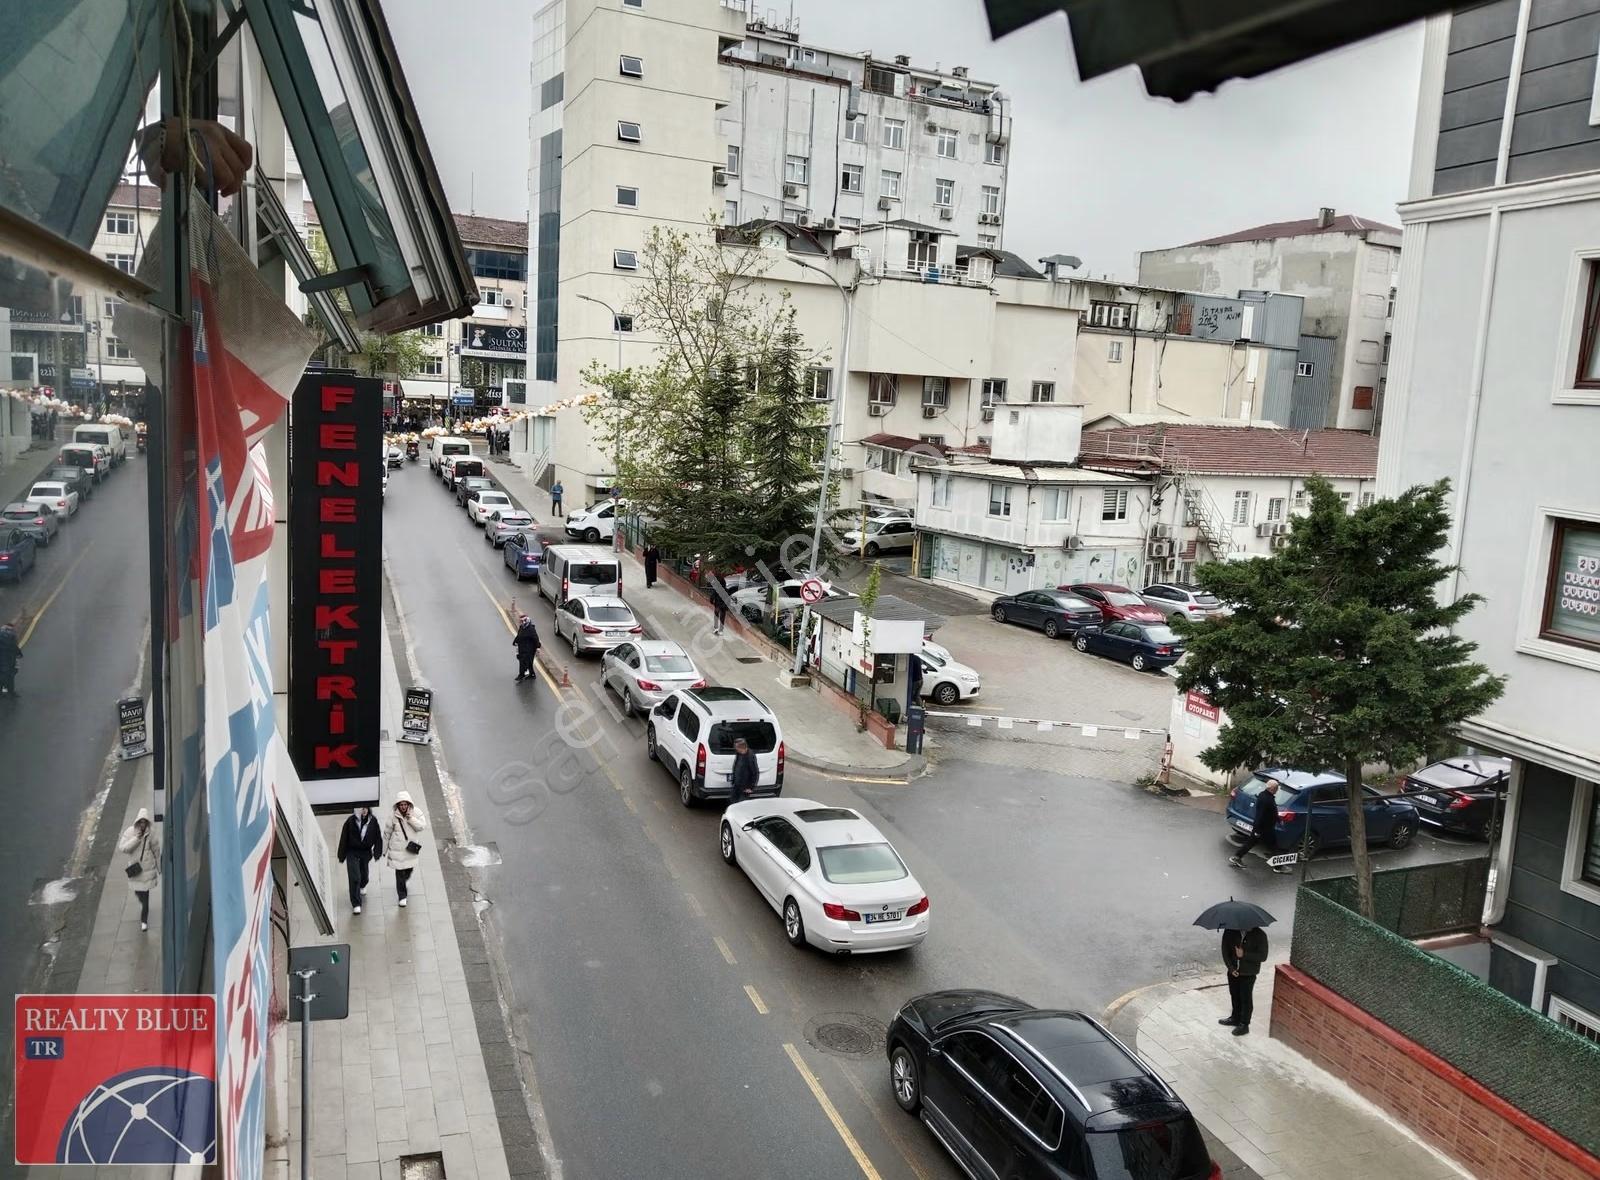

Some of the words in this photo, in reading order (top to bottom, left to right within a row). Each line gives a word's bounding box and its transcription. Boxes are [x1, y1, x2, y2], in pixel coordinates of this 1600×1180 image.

[1580, 559, 1597, 570] 23
[1564, 587, 1598, 599] KUTLU
[1562, 600, 1596, 612] OLSUN
